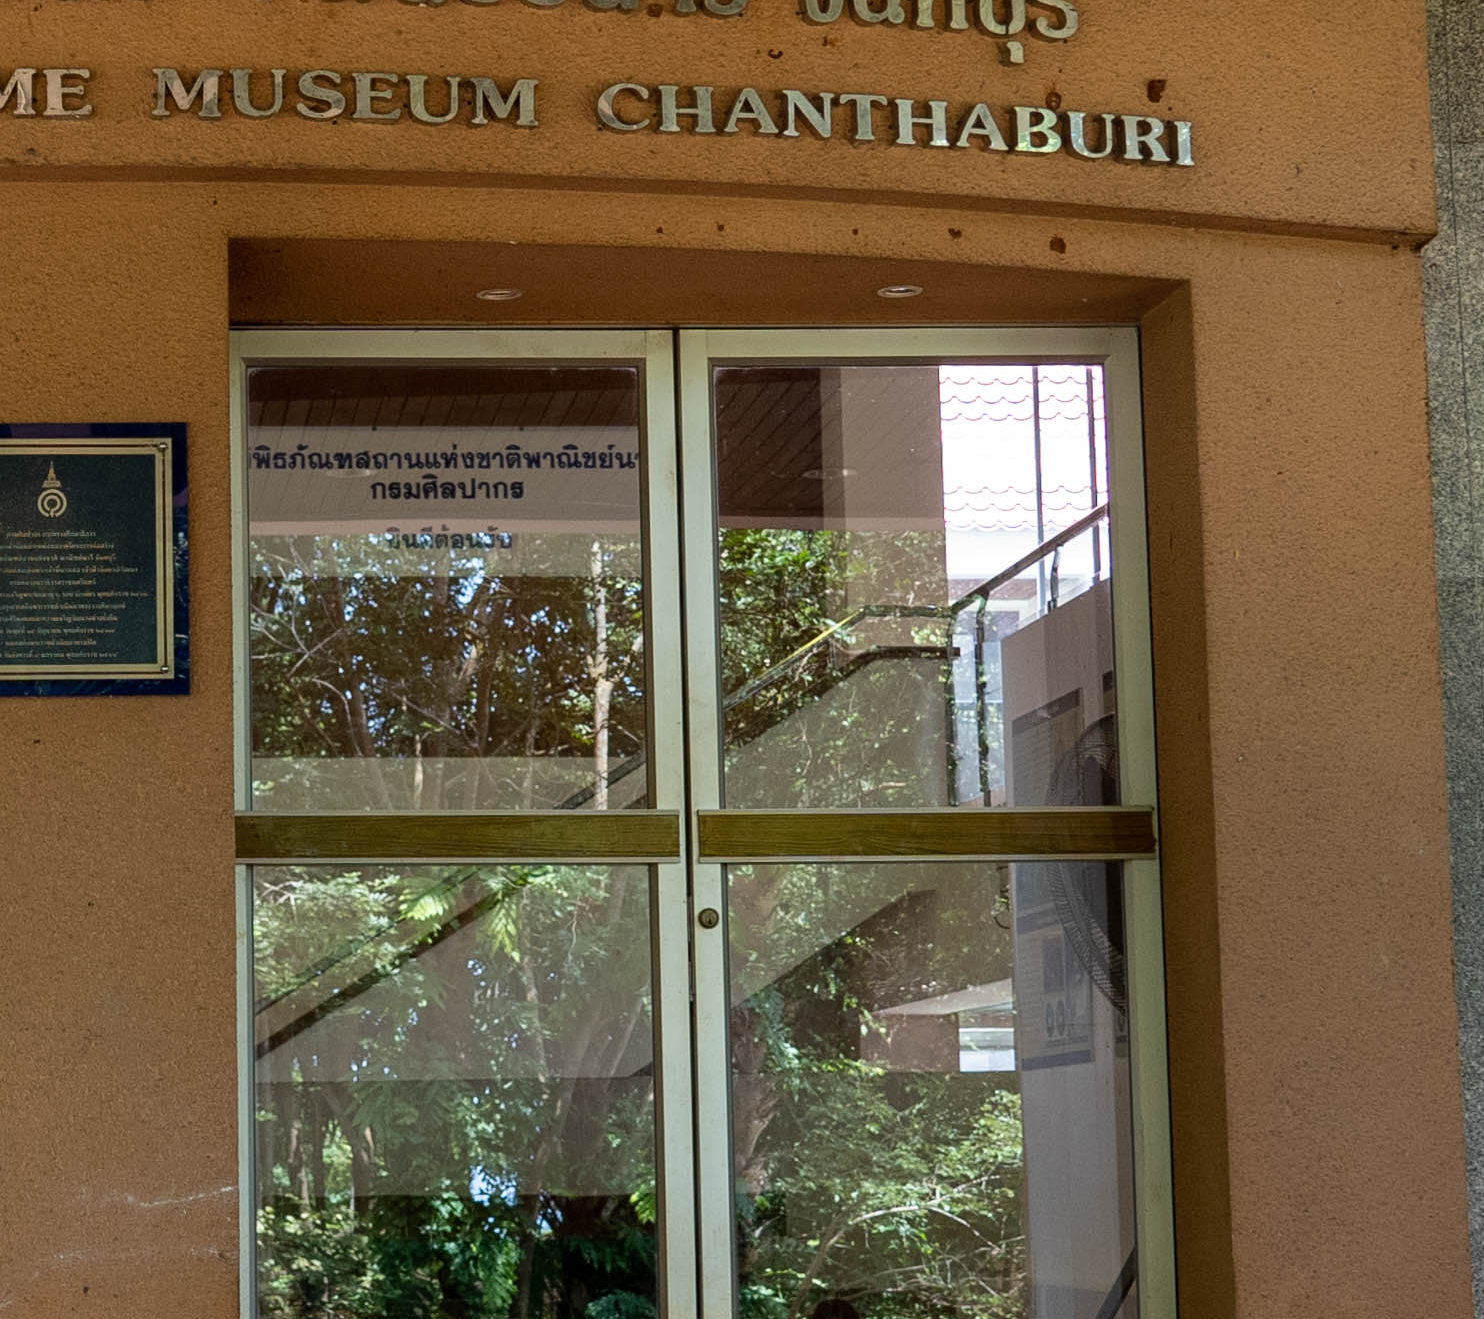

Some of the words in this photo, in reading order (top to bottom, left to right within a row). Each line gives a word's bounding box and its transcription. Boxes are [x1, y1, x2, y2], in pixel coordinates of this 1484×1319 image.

[151, 68, 539, 127] MUSEUM
[597, 82, 1195, 166] CHANTHABURI
[370, 474, 524, 499] กรมศิลปากร
